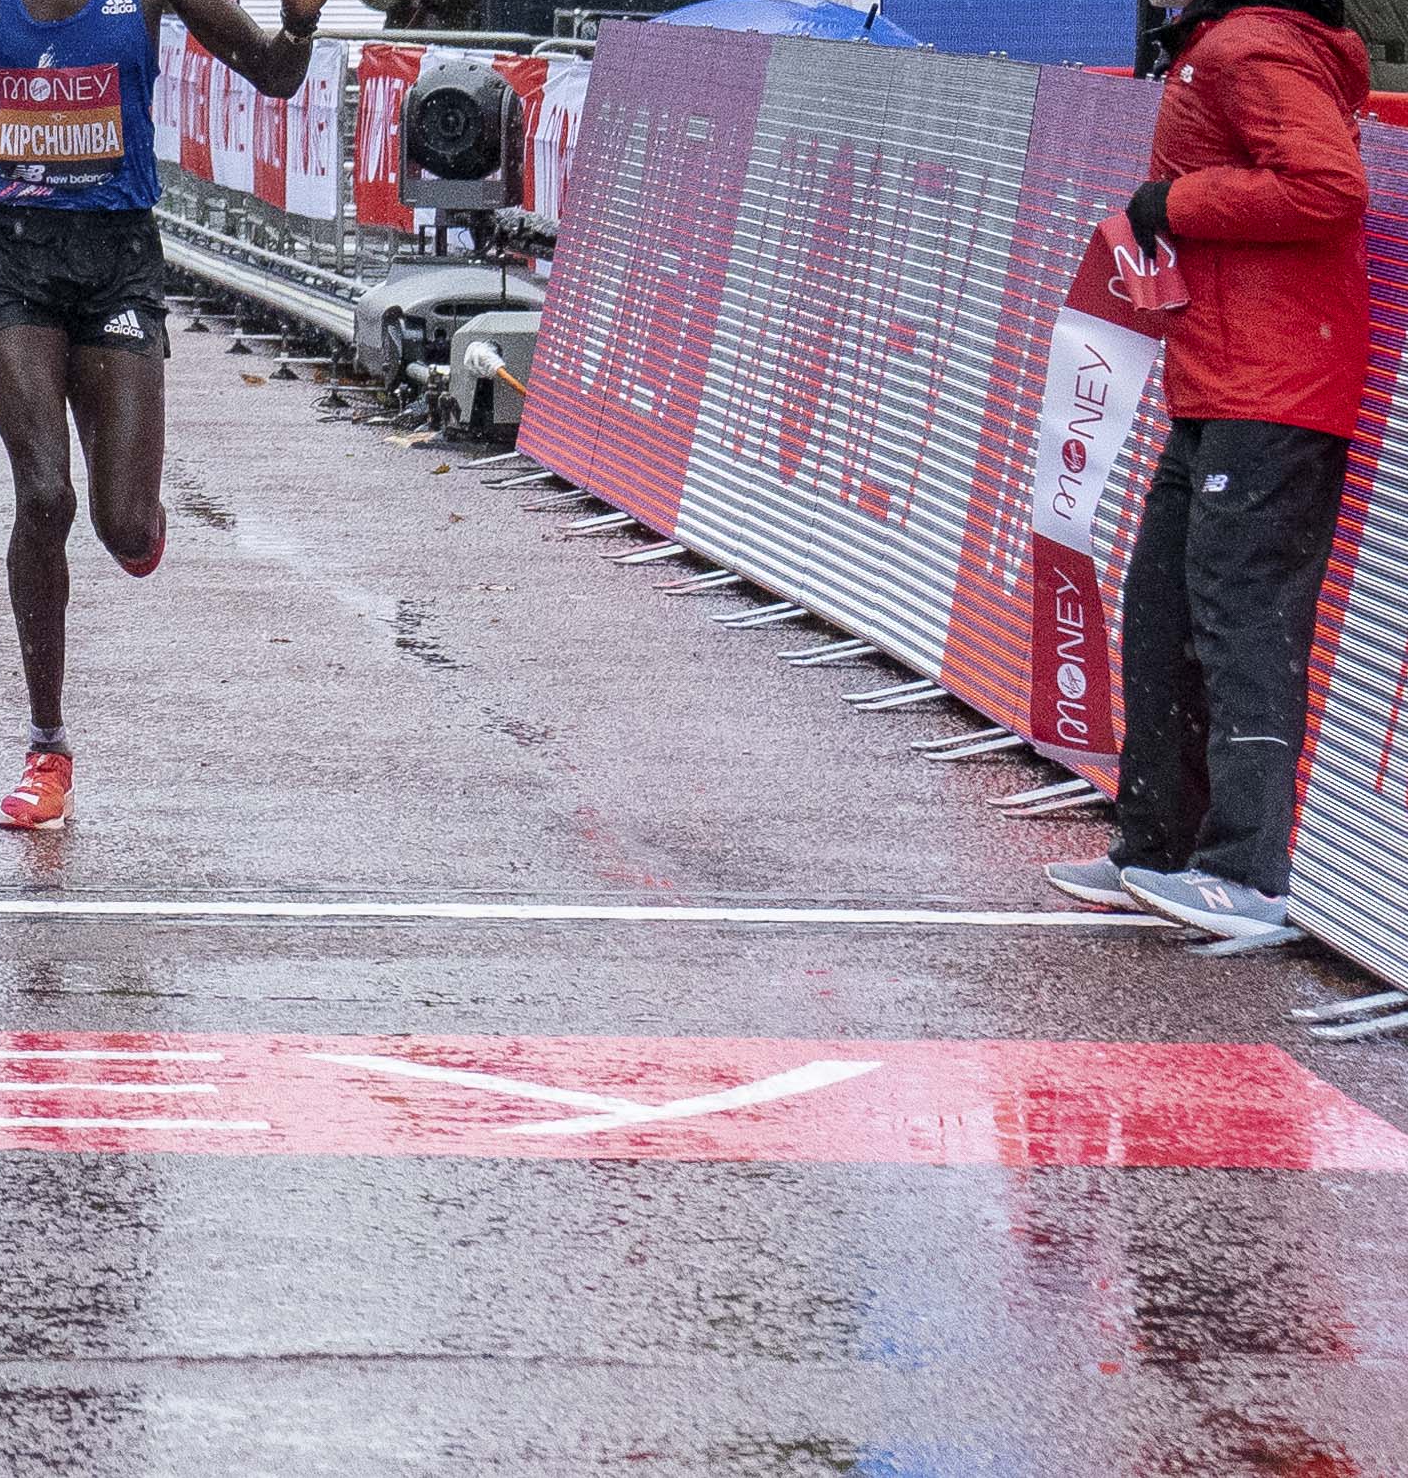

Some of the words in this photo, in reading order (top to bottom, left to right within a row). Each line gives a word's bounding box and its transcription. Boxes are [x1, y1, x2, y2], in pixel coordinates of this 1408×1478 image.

[102, 3, 137, 15] adidas
[3, 73, 112, 102] MONEY
[0, 121, 120, 156] KIPCHUMBA
[46, 175, 69, 184] new
[104, 323, 144, 339] adidas
[1053, 344, 1112, 521] MONEY
[1053, 566, 1089, 745] MONEY
